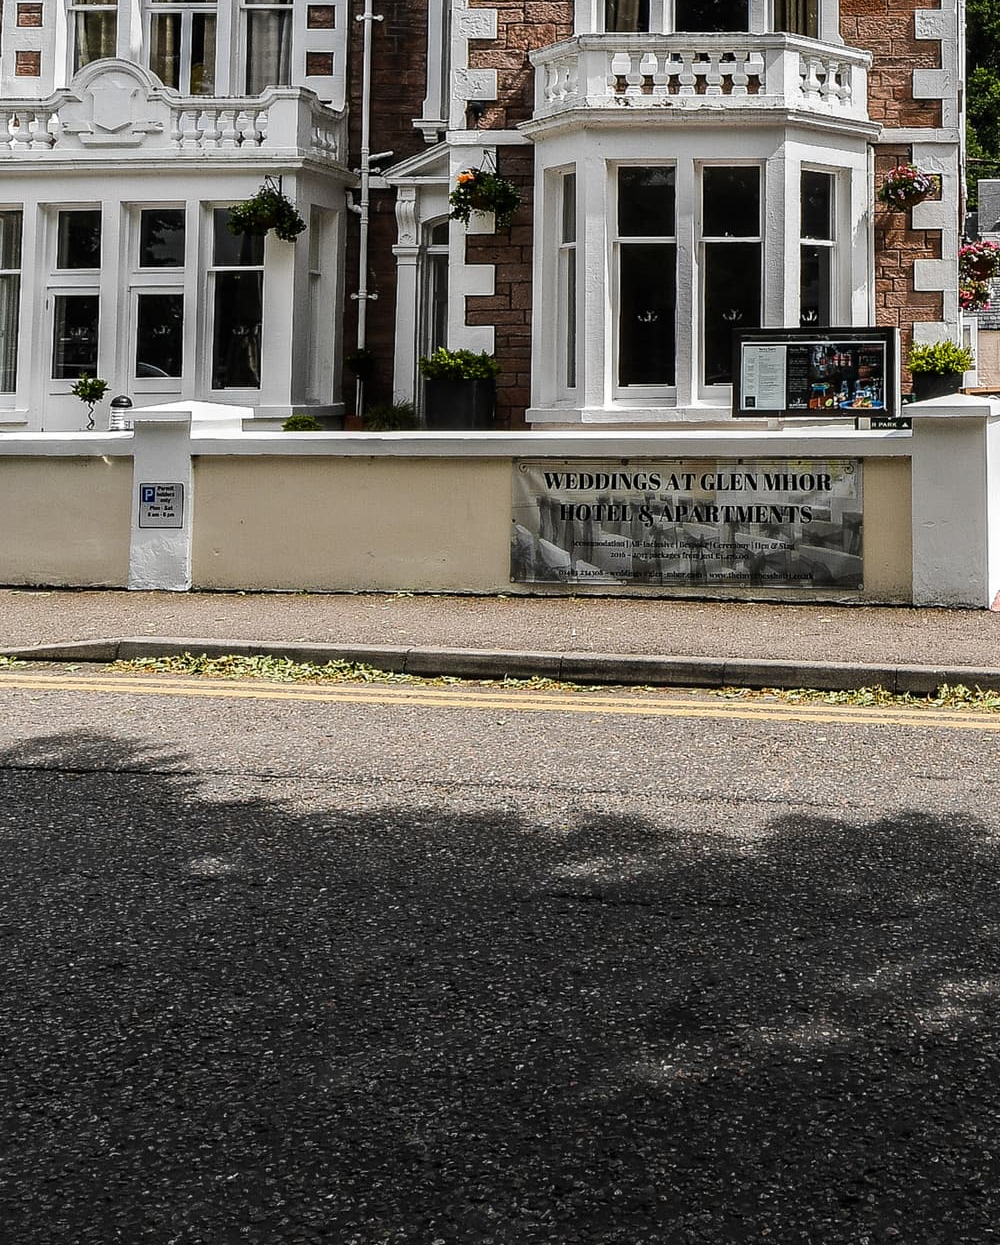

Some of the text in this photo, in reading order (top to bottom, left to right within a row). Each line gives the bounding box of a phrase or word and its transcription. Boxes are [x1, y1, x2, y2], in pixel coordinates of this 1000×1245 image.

[544, 472, 832, 491] WEDDINGS AT GLEN MHOR
[560, 503, 813, 528] HOTEL & APARTMENTS
